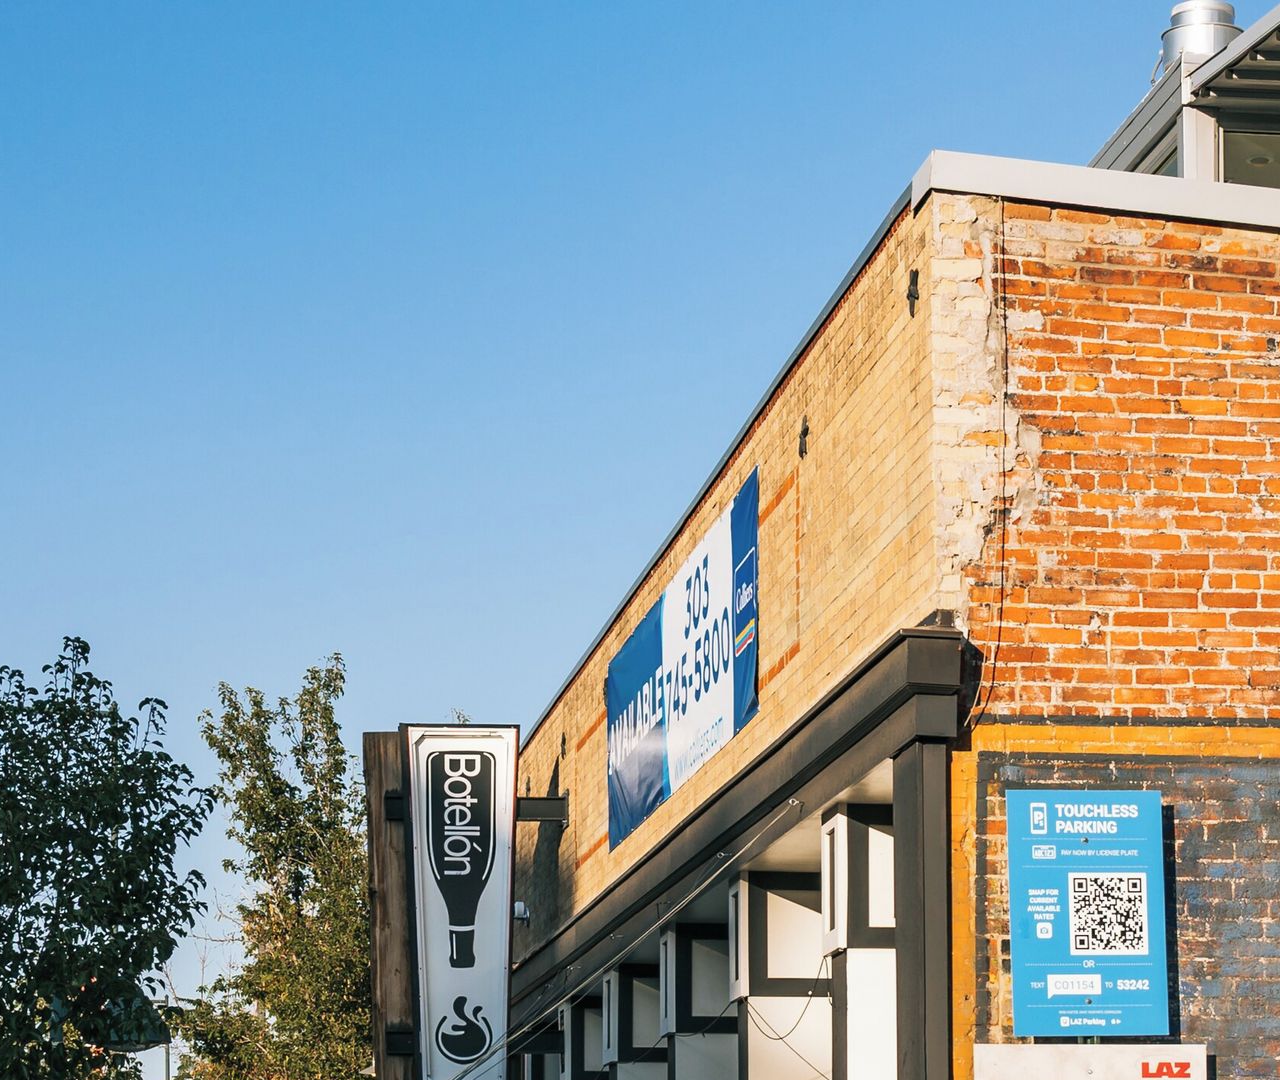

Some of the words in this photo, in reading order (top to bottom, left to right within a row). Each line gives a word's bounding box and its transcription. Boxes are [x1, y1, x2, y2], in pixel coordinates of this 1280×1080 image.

[684, 552, 709, 641] 303
[665, 605, 730, 733] 745-5800
[608, 665, 663, 776] AVAILABLE
[443, 753, 482, 876] Botellón
[1055, 804, 1139, 818] TOUCHLESS
[1055, 820, 1118, 834] PARKING
[1083, 960, 1095, 968] OR
[1117, 980, 1150, 990] 53242
[1141, 1062, 1191, 1079] LAZ
